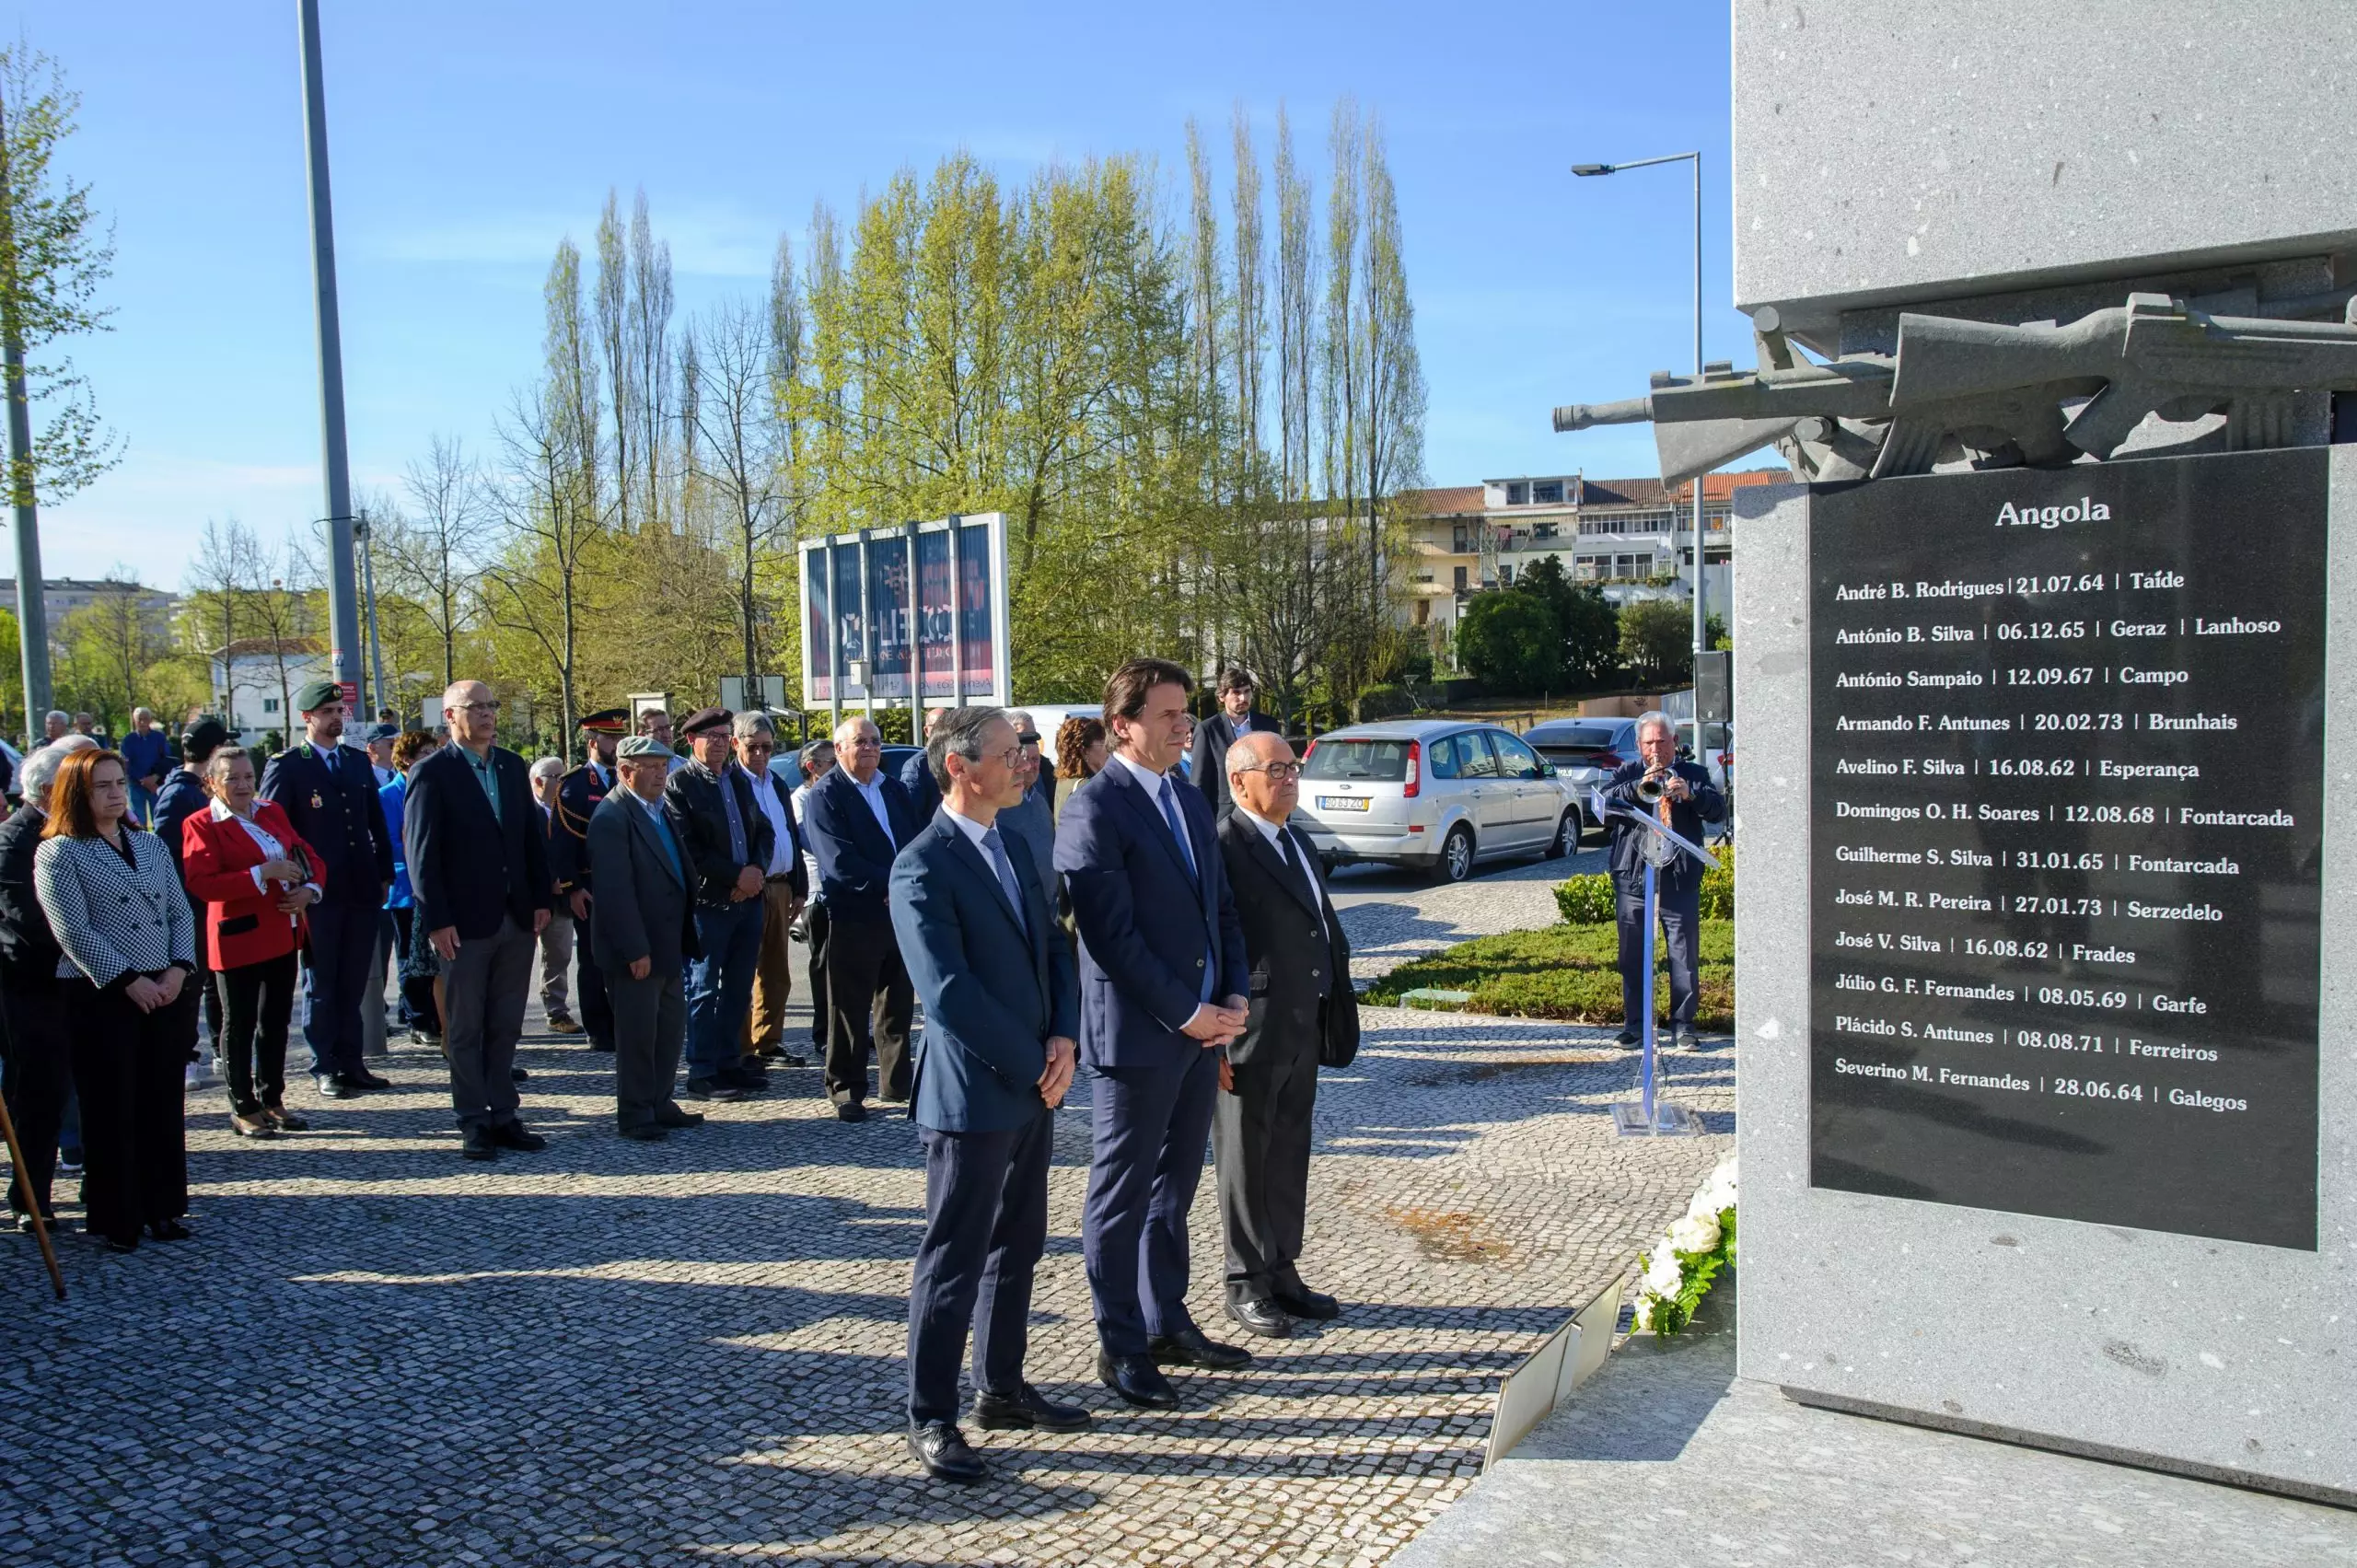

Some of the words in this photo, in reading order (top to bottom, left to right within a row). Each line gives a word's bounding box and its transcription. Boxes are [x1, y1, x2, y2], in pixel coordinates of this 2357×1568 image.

[1994, 495, 2111, 529] Angola
[1835, 583, 1887, 601] André
[1890, 582, 1910, 599] B.
[1914, 579, 2004, 600] Rodrigues
[2015, 574, 2105, 596] 21.07.64
[2129, 569, 2185, 589] Taíde
[1835, 627, 1903, 645] António
[1906, 626, 1926, 643] B.
[1931, 624, 1975, 643] Silva
[1997, 621, 2085, 641] 06.12.65
[2109, 620, 2167, 637] Geraz
[2194, 616, 2282, 635] Lanhoso
[1835, 671, 1903, 688] António
[1906, 669, 1983, 690] Sampaio
[2007, 667, 2094, 686] 12.09.67
[2119, 666, 2189, 687] Campo
[1835, 714, 1914, 731] Armando
[1918, 714, 1933, 731] F.
[1937, 714, 2011, 731] Antunes
[2034, 713, 2124, 731] 20.02.73
[2148, 712, 2238, 730] Brunhais
[1835, 758, 1898, 775] Avelino
[1902, 758, 1918, 775] F.
[1922, 758, 1966, 775] Silva
[1989, 759, 2075, 777] 16.08.62
[2098, 759, 2200, 782] Esperança
[1836, 801, 1921, 822] Domingos
[1925, 802, 1947, 819] O.
[1951, 803, 1973, 820] H.
[1978, 803, 2040, 822] Soares
[2064, 805, 2155, 824] 12.08.68
[2179, 807, 2295, 827] Fontarcada
[1835, 845, 1922, 865] Guilherme
[1926, 848, 1945, 865] S.
[1949, 848, 1993, 867] Silva
[2015, 851, 2105, 871] 31.01.65
[2128, 854, 2240, 875] Fontarcada
[1835, 888, 1874, 905] José
[1877, 889, 1899, 907] M.
[1904, 891, 1923, 908] R.
[1928, 892, 1992, 912] Pereira
[2014, 895, 2103, 916] 27.01.73
[2127, 900, 2223, 922] Serzedelo
[1834, 931, 1874, 948] José
[1877, 933, 1895, 950] V.
[1899, 934, 1942, 953] Silva
[1964, 937, 2049, 959] 16.08.62
[2072, 944, 2136, 964] Frades
[1835, 973, 1876, 992] Júlio
[1880, 976, 1899, 993] G.
[1904, 978, 1920, 994] F.
[1924, 979, 2015, 1002] Fernandes
[2038, 986, 2128, 1009] 08.05.69
[2152, 994, 2207, 1015] Garfe
[1835, 1015, 1897, 1036] Plácido
[1900, 1020, 1918, 1039] S.
[1922, 1023, 1994, 1044] Antunes
[2016, 1029, 2104, 1053] 08.08.71
[2129, 1039, 2219, 1062] Ferreiros
[1834, 1057, 1908, 1080] Severino
[1911, 1064, 1934, 1083] M.
[1938, 1067, 2031, 1091] Fernandes
[2054, 1077, 2144, 1102] 28.06.64
[2168, 1087, 2247, 1113] Galegos
